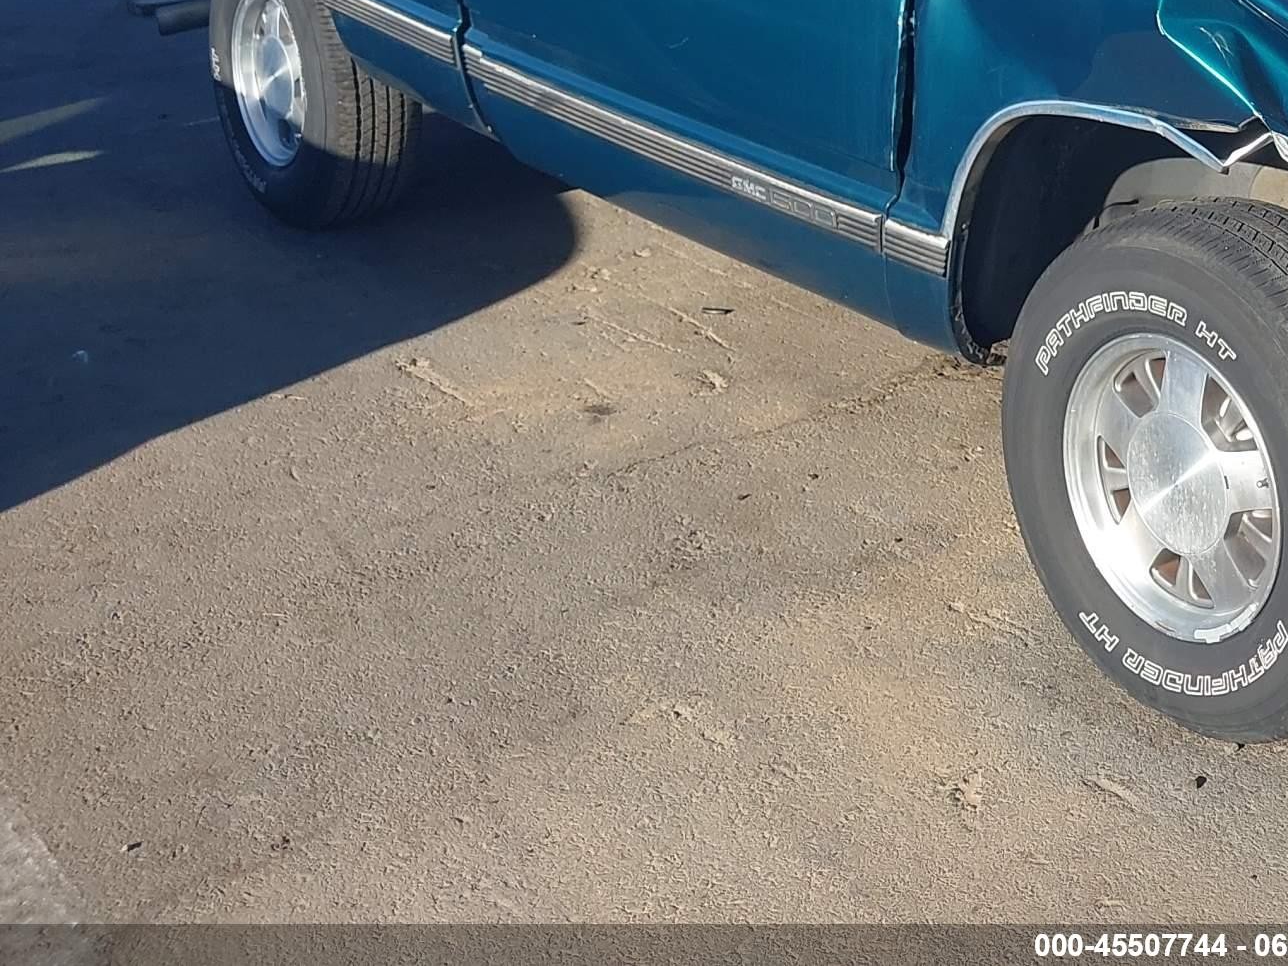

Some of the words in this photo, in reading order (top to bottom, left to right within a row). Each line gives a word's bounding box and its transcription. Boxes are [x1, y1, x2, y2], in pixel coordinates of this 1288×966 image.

[731, 176, 767, 200] GMC
[1035, 291, 1188, 376] PATHFINDER
[1195, 321, 1237, 361] HT
[1078, 612, 1119, 652] HT
